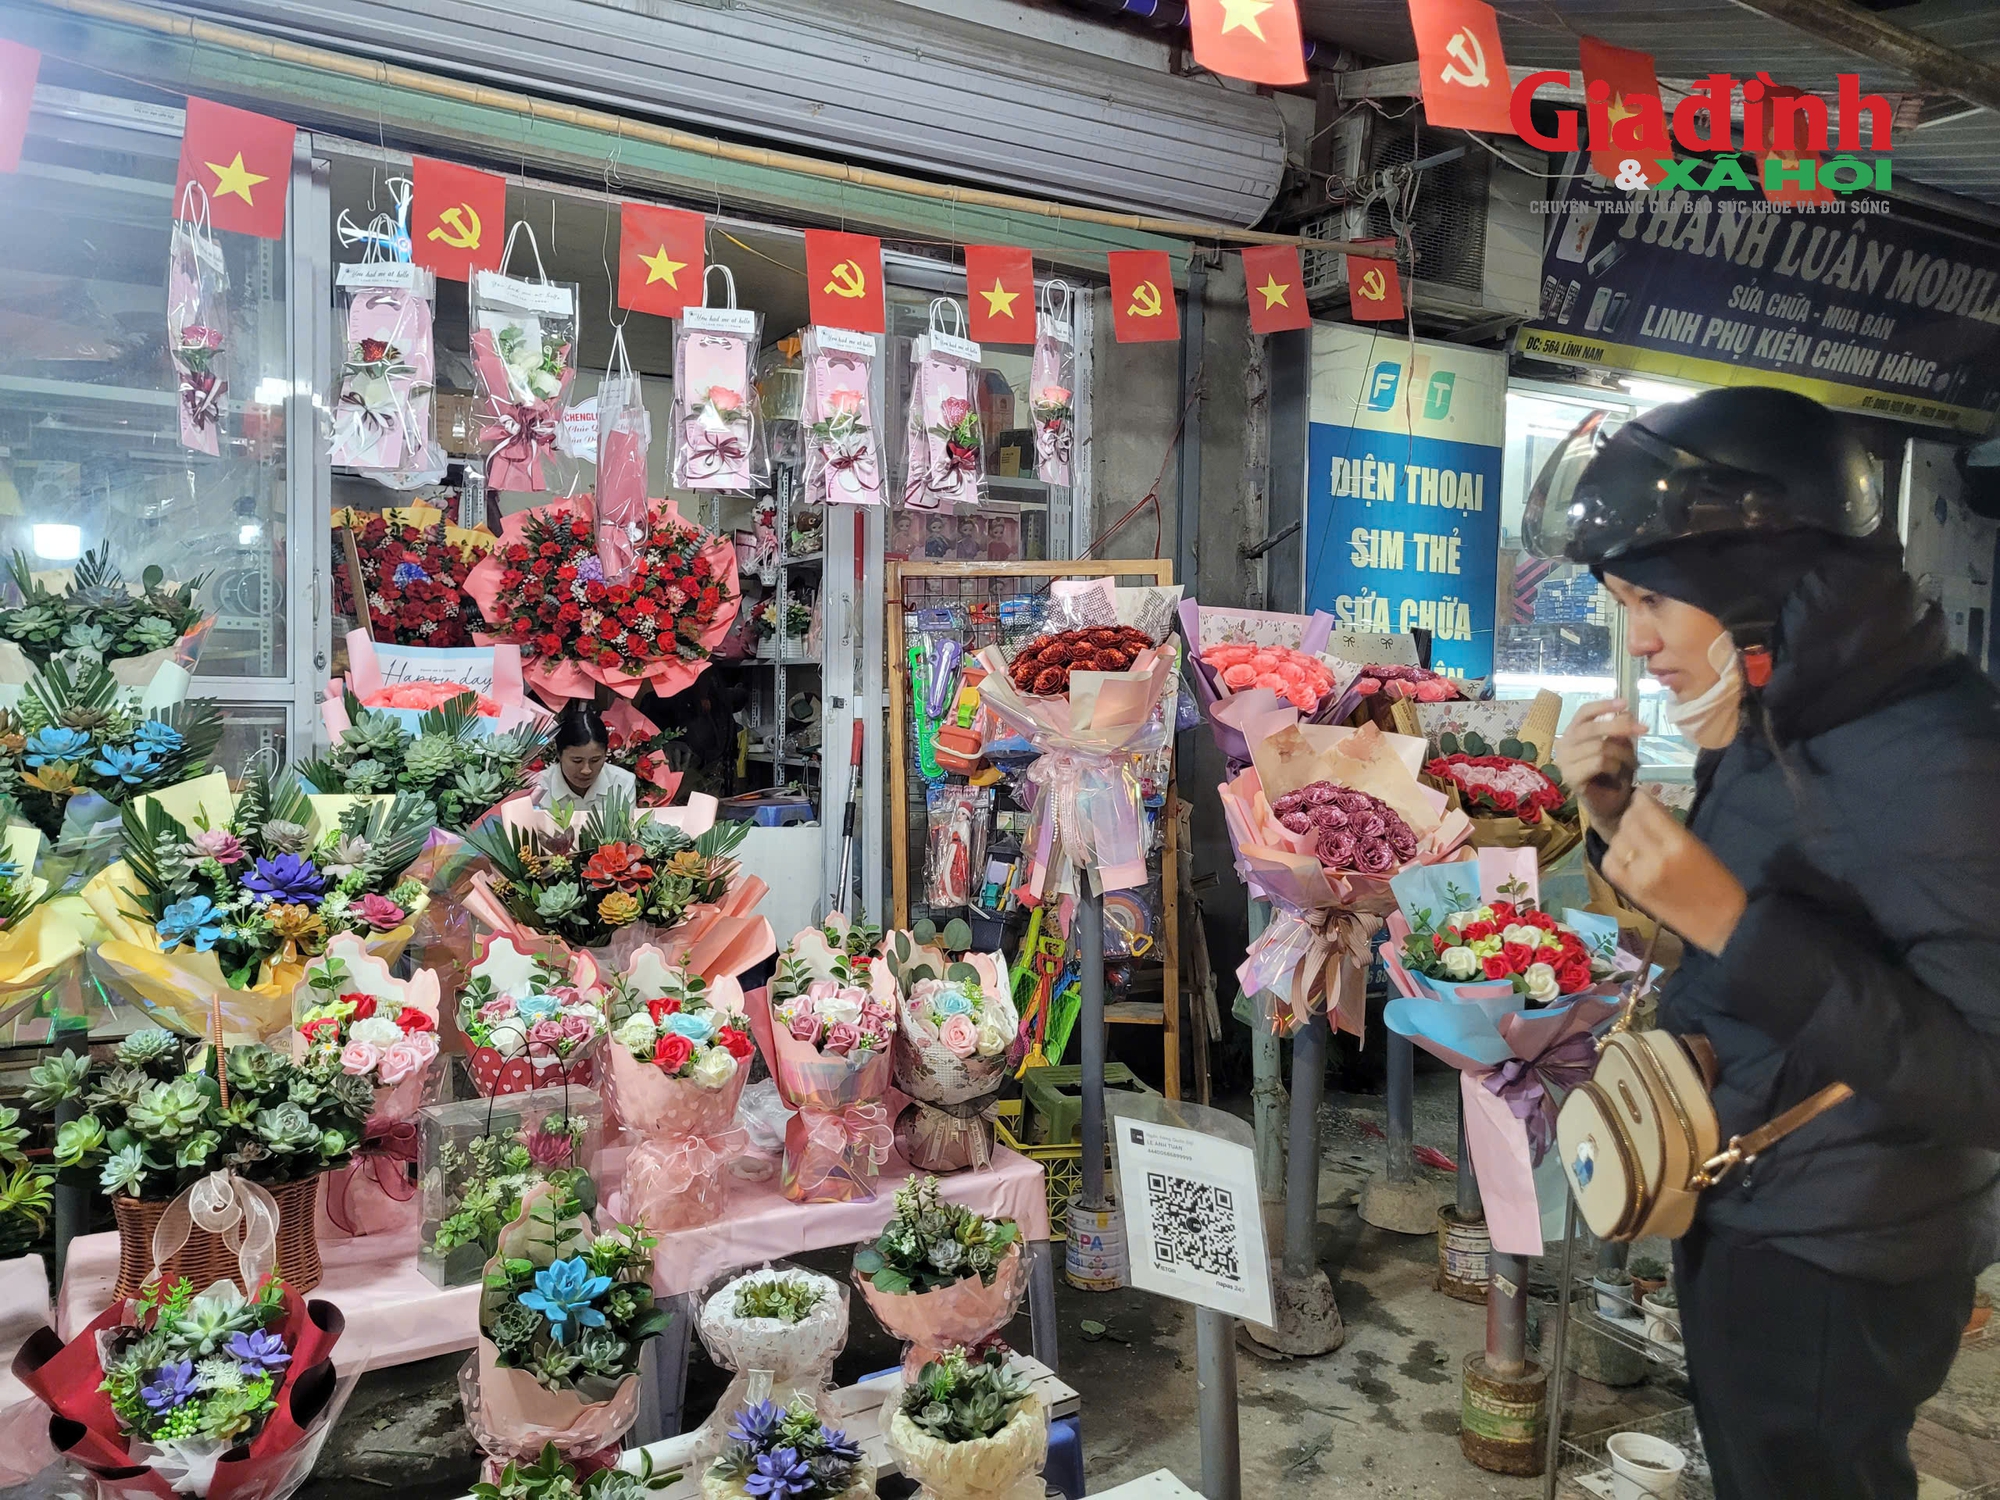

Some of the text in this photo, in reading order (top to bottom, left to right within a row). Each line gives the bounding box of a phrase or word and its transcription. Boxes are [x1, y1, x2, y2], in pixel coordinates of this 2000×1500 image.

[1773, 218, 1894, 295] LUÂN
[1728, 278, 1762, 314] SỬA
[1765, 292, 1812, 322] CHỮA
[1822, 305, 1860, 333] MUA
[1859, 311, 1896, 340] BÁN
[1543, 339, 1560, 354] 564
[1581, 346, 1604, 361] NAM
[1640, 305, 1703, 344] LINH
[1700, 317, 1755, 361] PHỤ
[1753, 326, 1812, 367] KIỆN
[1811, 338, 1881, 378] CHÍNH
[1330, 453, 1484, 518] ĐIỆN THOẠI
[1351, 527, 1462, 575] SIM THẺ
[1335, 586, 1472, 641] SỬA CHỮA
[459, 666, 494, 694] day
[1215, 1280, 1233, 1290] napas
